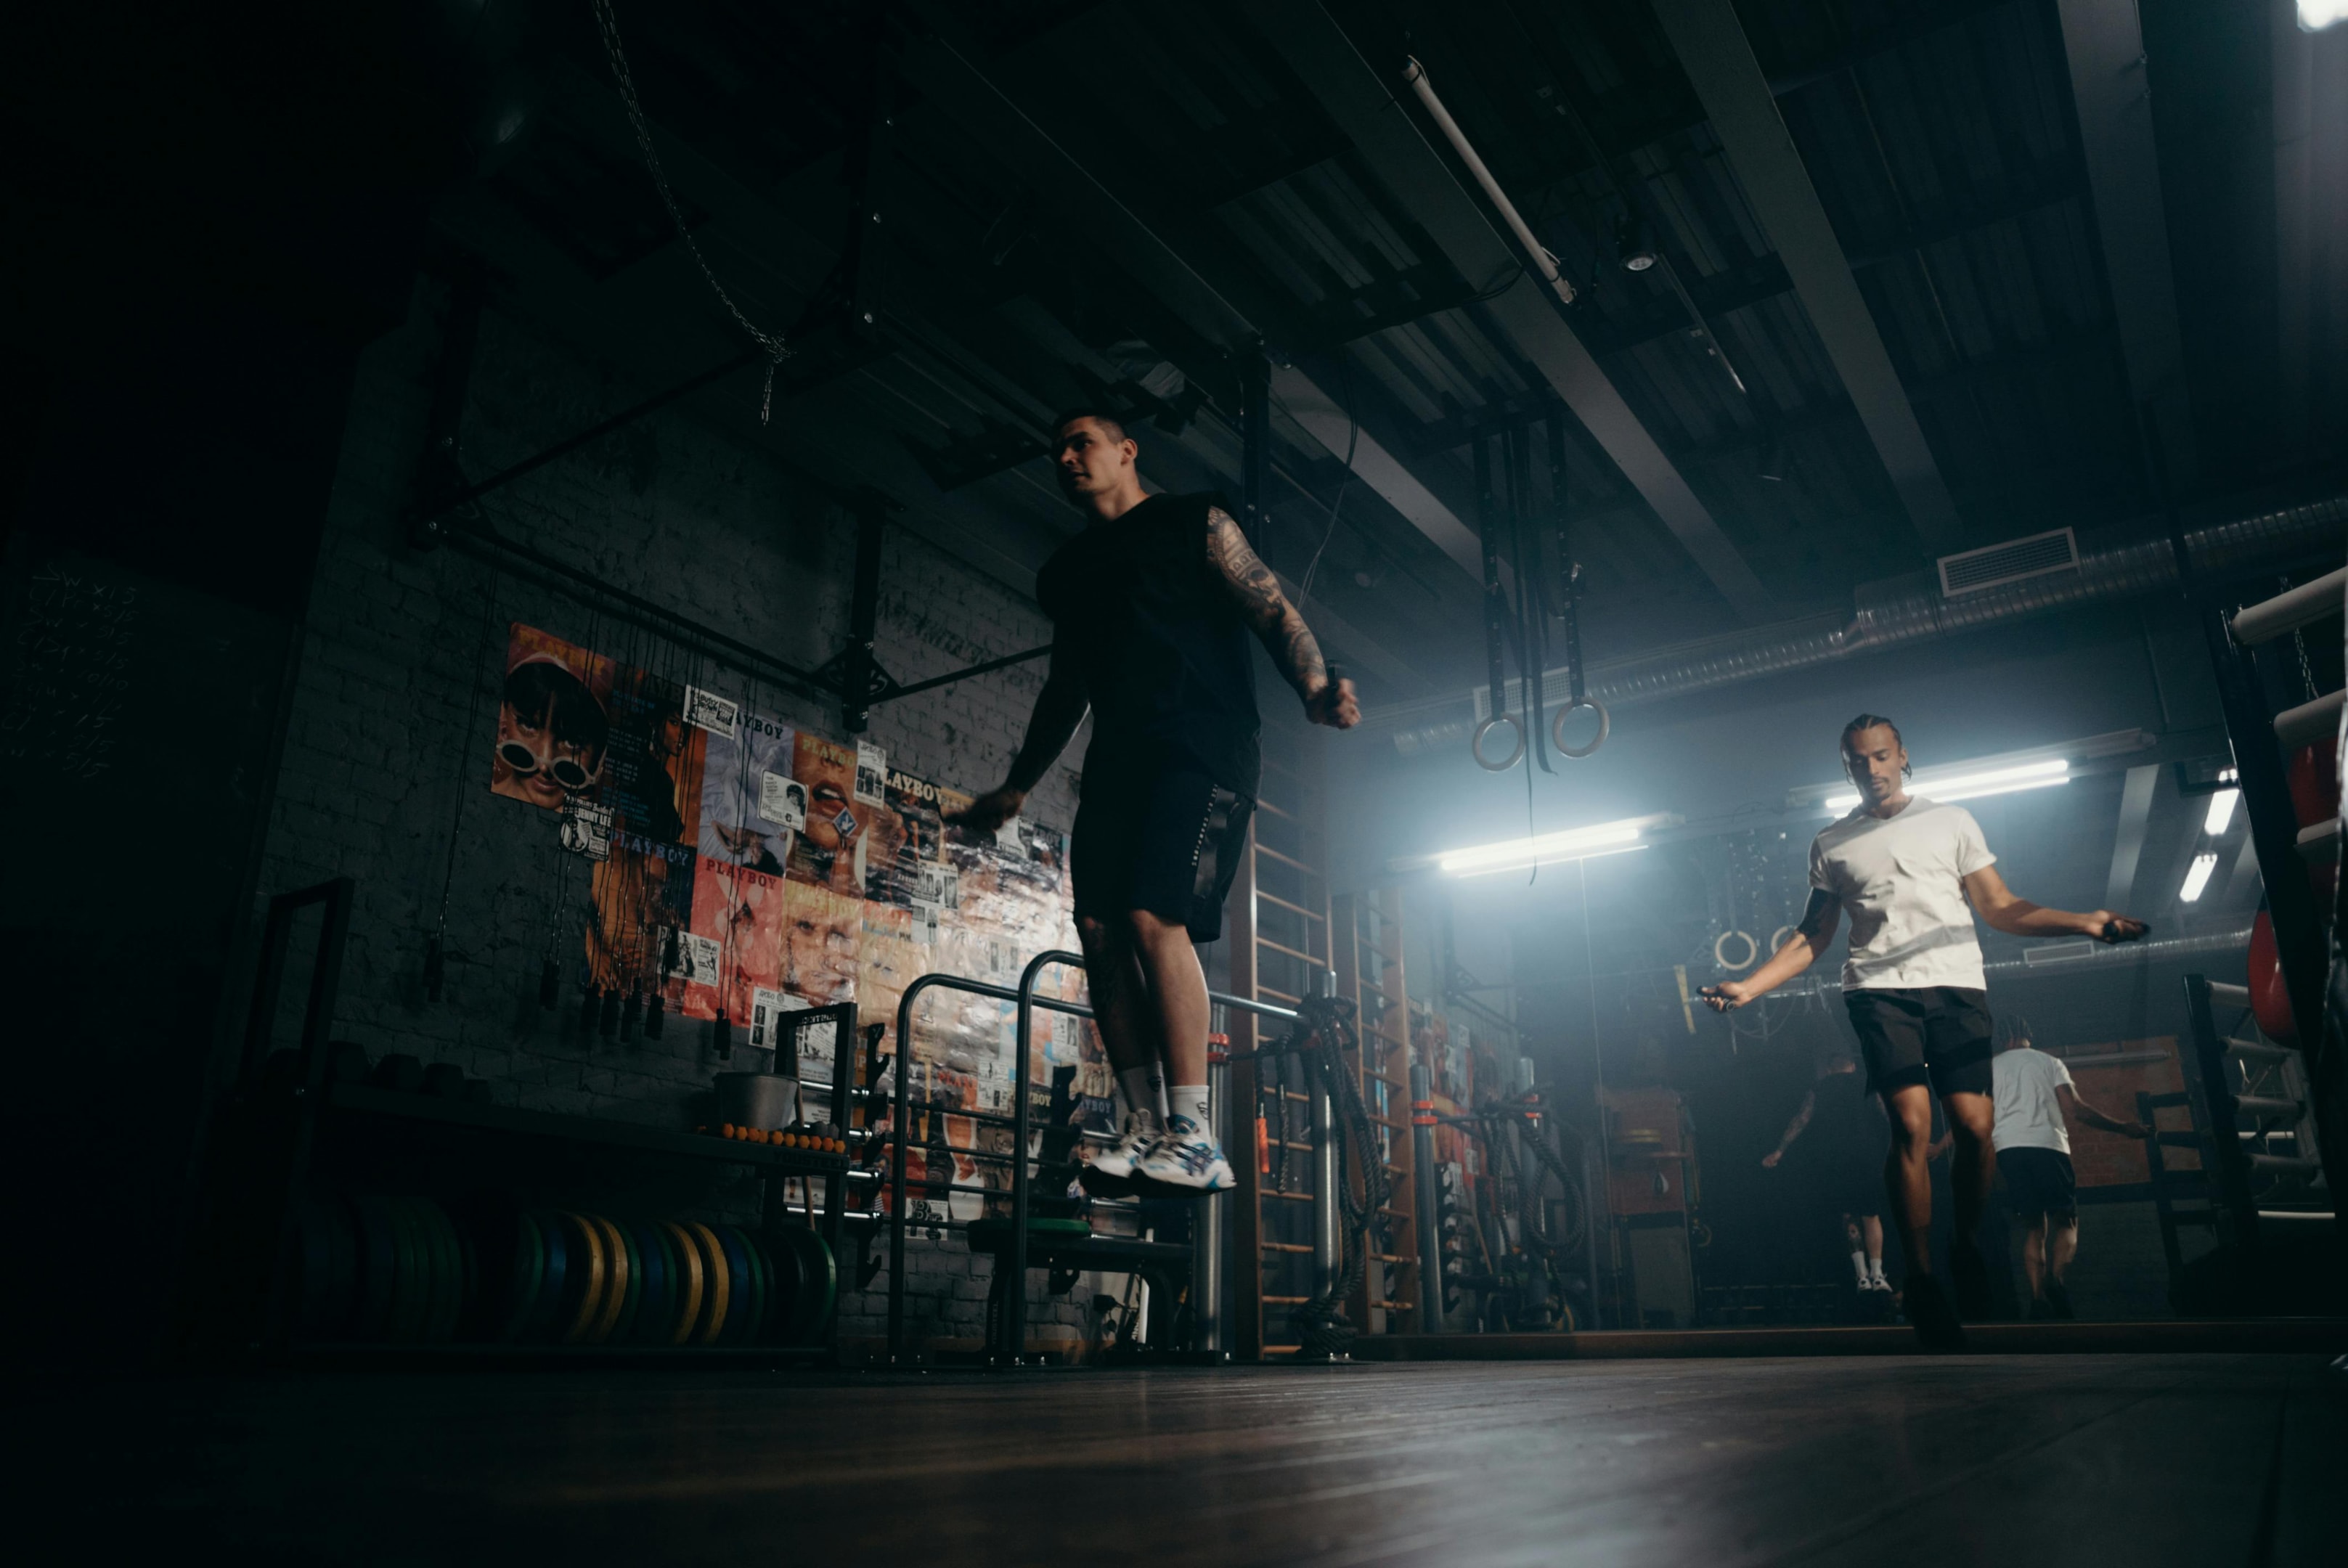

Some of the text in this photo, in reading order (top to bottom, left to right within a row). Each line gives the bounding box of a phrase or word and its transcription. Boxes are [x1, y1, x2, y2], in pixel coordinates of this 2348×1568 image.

[735, 711, 784, 740] AYBOY
[802, 739, 855, 768] PLAYBO
[884, 767, 942, 805] LAYBOY
[706, 859, 777, 889] PLAYBOY
